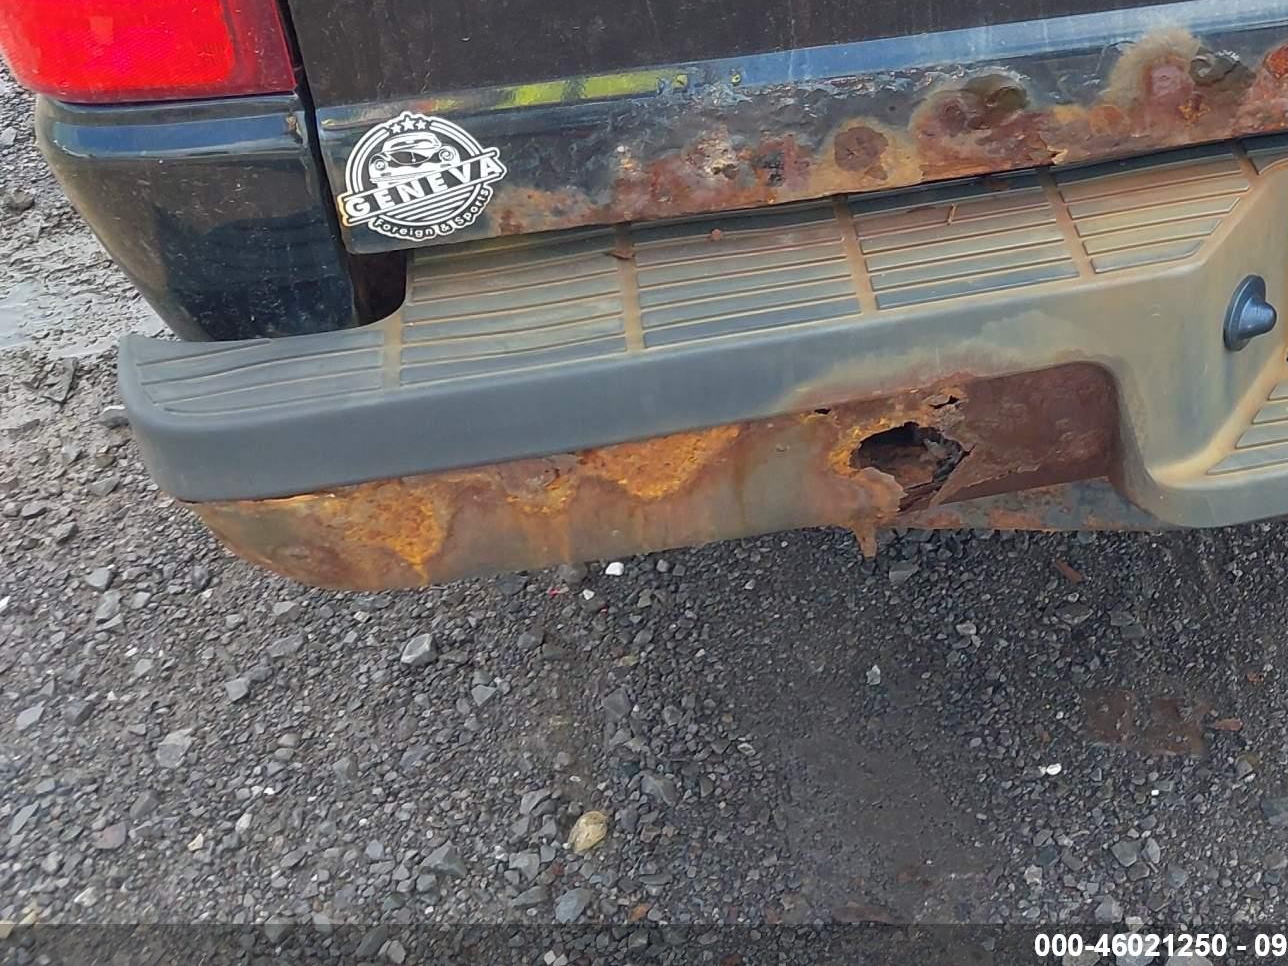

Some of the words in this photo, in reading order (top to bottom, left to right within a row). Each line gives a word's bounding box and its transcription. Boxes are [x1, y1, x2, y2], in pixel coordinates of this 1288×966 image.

[345, 156, 503, 217] GENEVA
[373, 217, 436, 238] Foreign
[440, 223, 452, 232] &
[456, 188, 490, 225] Sports
